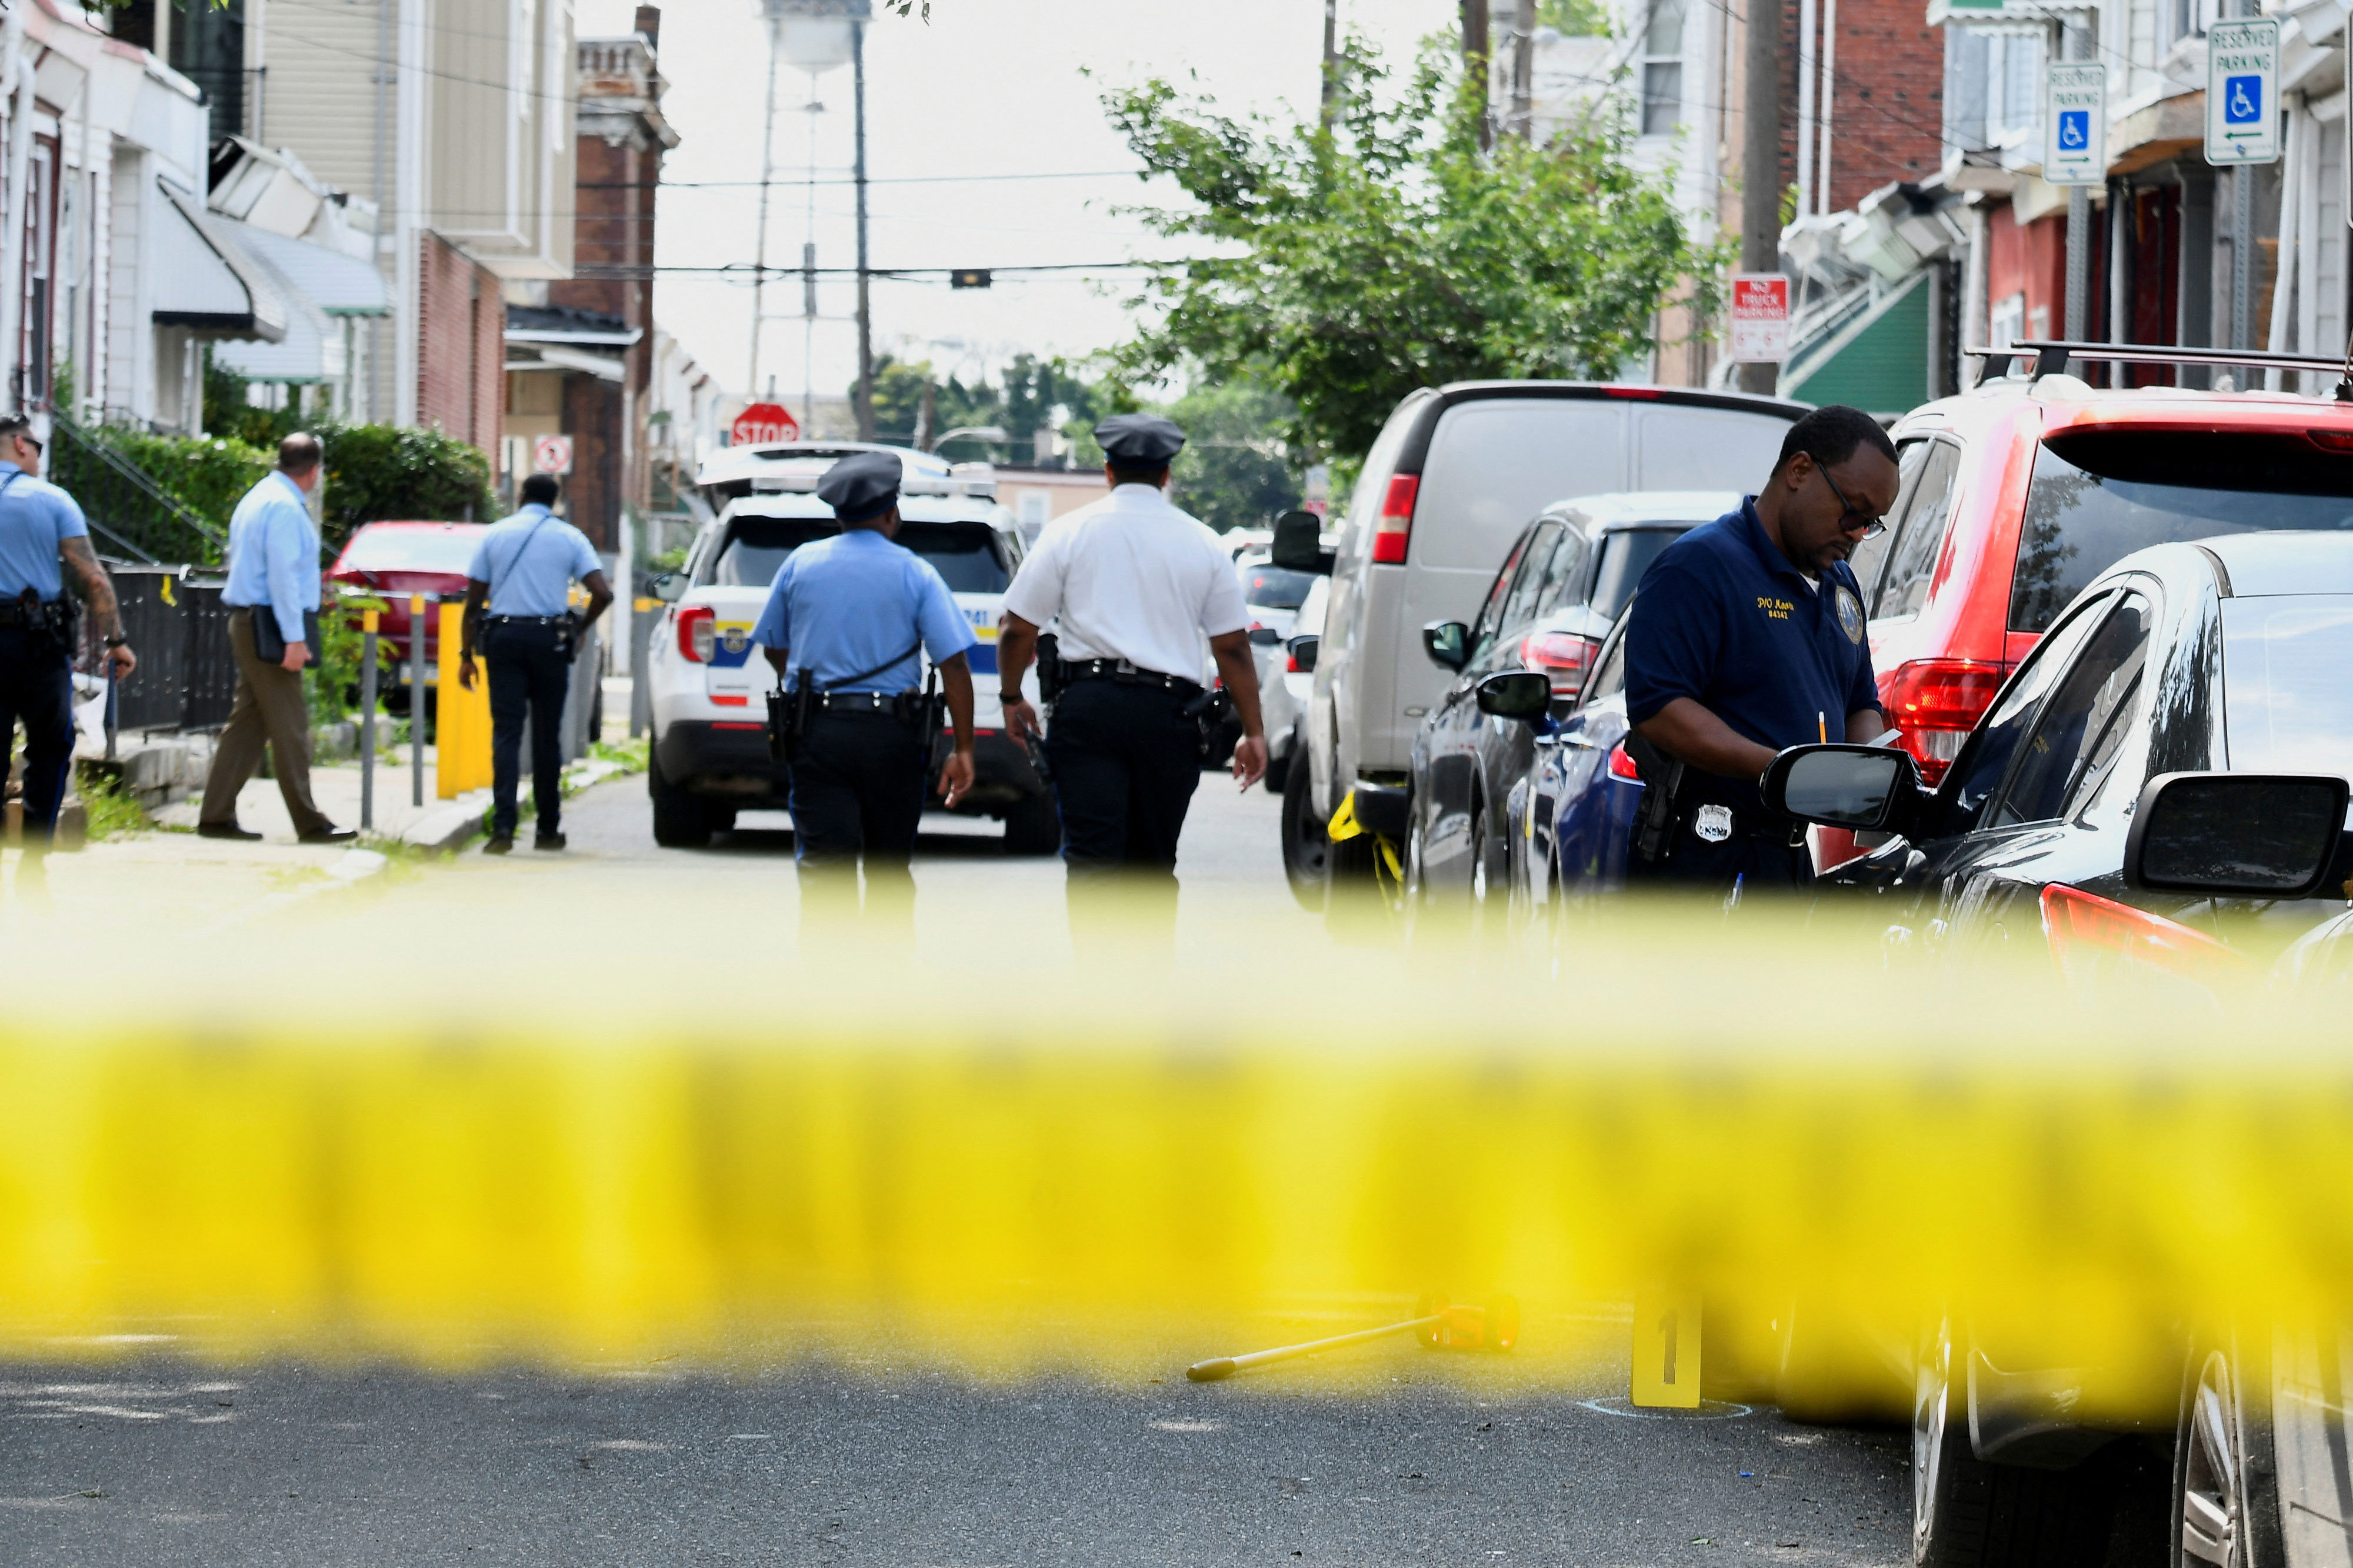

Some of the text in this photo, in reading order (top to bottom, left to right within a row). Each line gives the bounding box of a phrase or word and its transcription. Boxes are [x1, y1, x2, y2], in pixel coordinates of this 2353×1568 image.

[2212, 29, 2274, 49] RESERVED
[2216, 54, 2271, 71] PARKING
[2050, 71, 2104, 86] RESERVED
[2054, 91, 2099, 106] PARKING
[1750, 281, 1771, 294] NO
[1742, 294, 1779, 308] TRUCK
[1735, 307, 1786, 319] PARKING
[734, 421, 798, 446] STOP
[1757, 597, 1772, 609] P/O
[1658, 1309, 1677, 1384] 1
